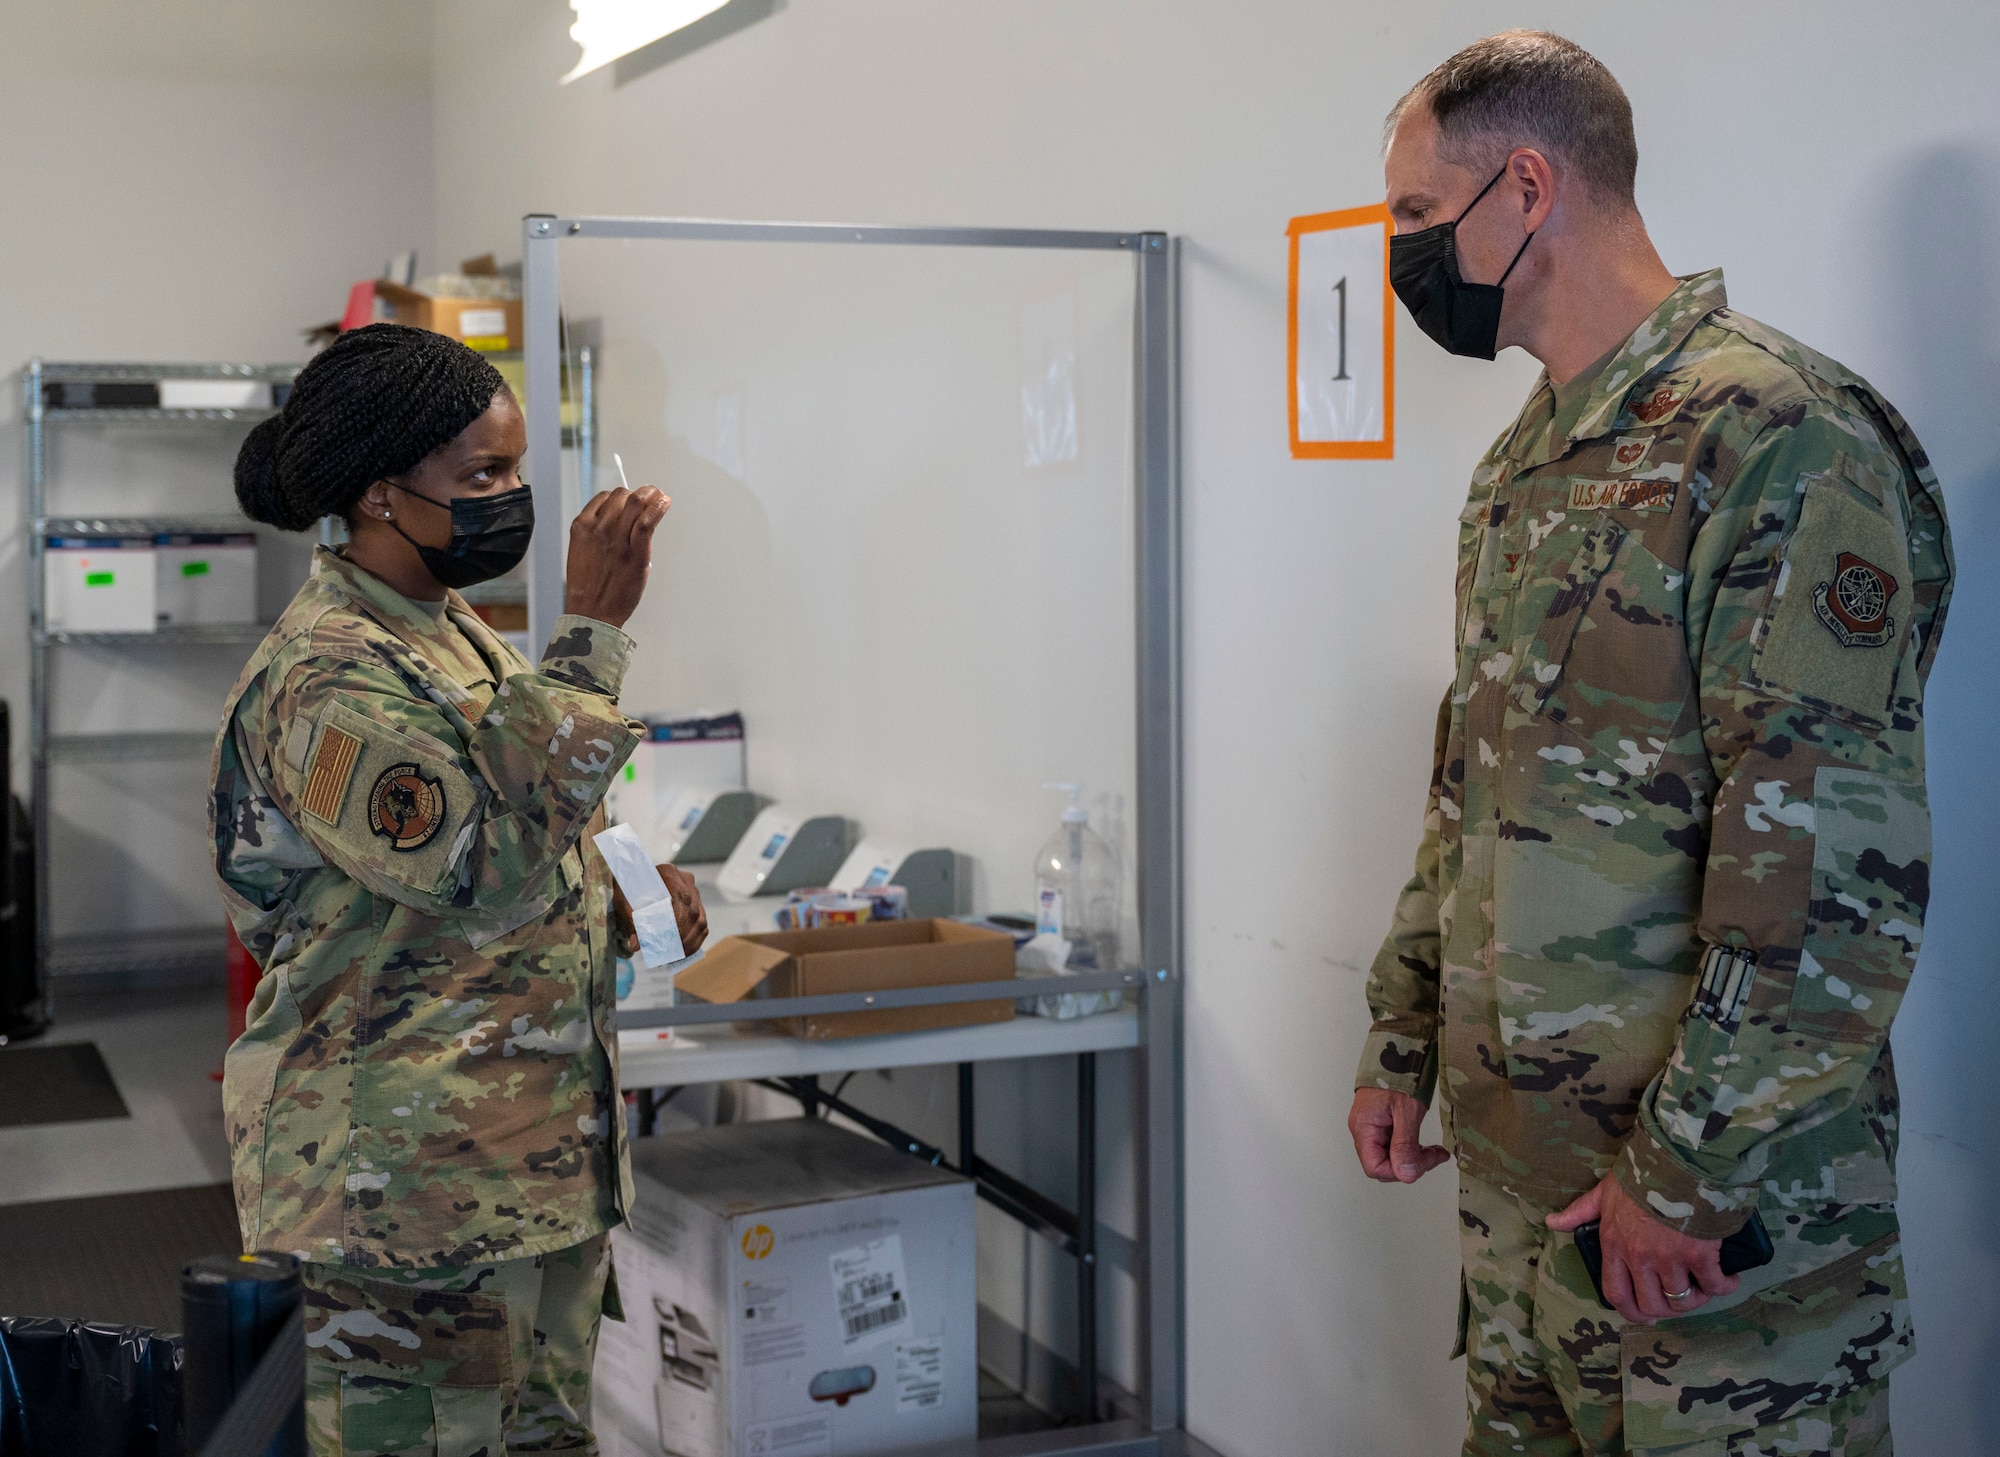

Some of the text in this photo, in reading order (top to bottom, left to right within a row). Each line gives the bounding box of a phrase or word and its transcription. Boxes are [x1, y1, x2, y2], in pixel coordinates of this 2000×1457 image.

[1331, 275, 1352, 381] 1
[1572, 482, 1669, 508] U.S. AIR FORCE
[1819, 605, 1830, 617] AIR
[744, 1224, 772, 1260] hp
